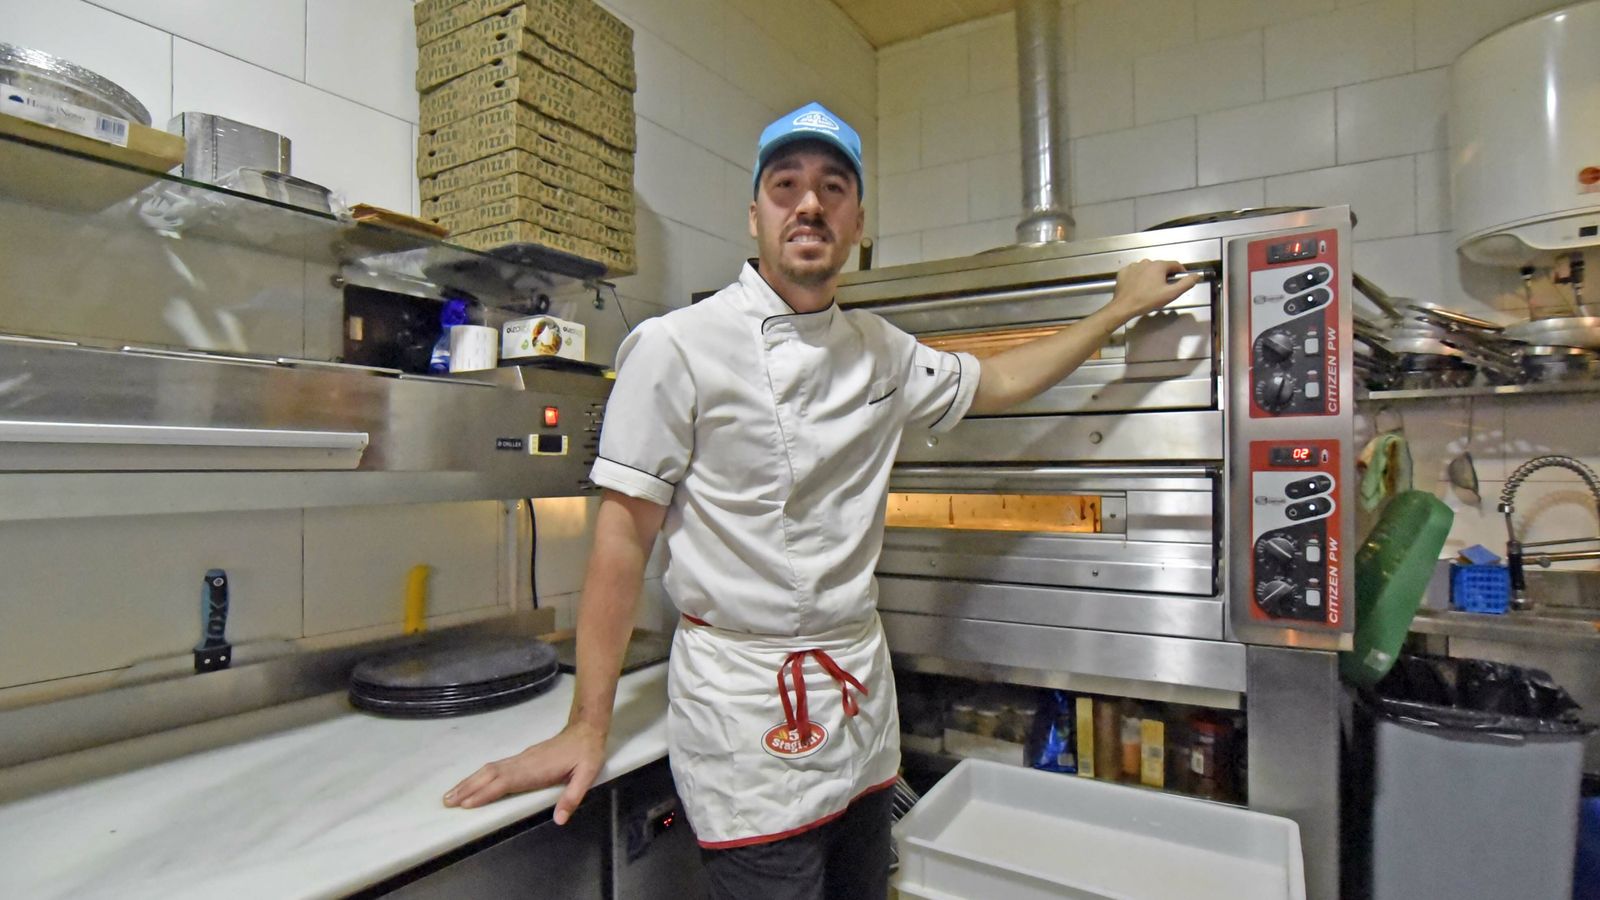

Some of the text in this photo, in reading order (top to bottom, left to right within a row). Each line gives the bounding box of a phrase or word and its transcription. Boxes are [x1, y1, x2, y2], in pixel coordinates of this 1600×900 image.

[429, 17, 458, 36] PIZZA
[484, 15, 518, 34] PIZZA
[431, 39, 462, 58] PIZZA
[480, 40, 514, 58] PIZZA
[428, 63, 458, 82] PIZZA
[478, 66, 509, 85] PIZZA
[479, 89, 511, 105] PIZZA
[478, 110, 510, 126] PIZZA
[478, 135, 510, 151] PIZZA
[480, 158, 511, 174] PIZZA
[480, 182, 512, 198] PIZZA
[480, 204, 512, 218] PIZZA
[482, 230, 514, 244] PIZZA
[1327, 327, 1338, 413] CITIZEN PW
[1293, 448, 1309, 459] 02
[1328, 537, 1339, 624] CITIZEN PW
